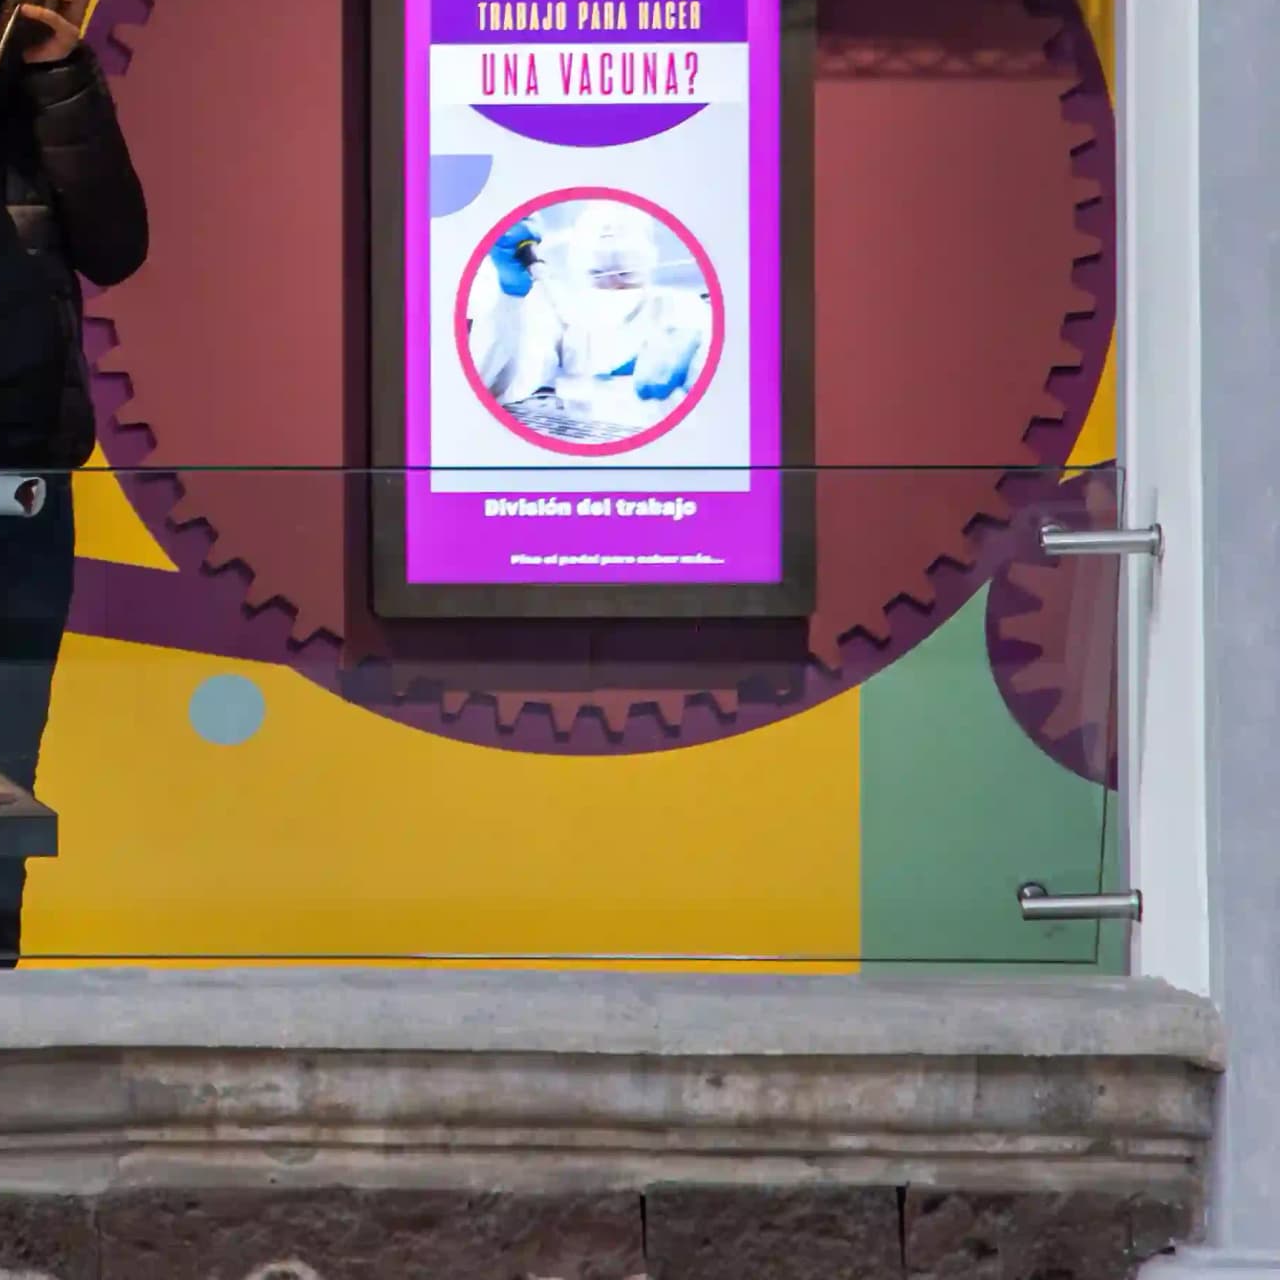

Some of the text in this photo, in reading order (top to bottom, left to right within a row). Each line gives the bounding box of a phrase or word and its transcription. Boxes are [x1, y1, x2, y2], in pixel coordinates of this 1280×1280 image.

[477, 1, 702, 31] TRABAJO PARA HACER
[481, 51, 699, 96] UNA VACUNA?
[484, 496, 698, 521] División del trabajo
